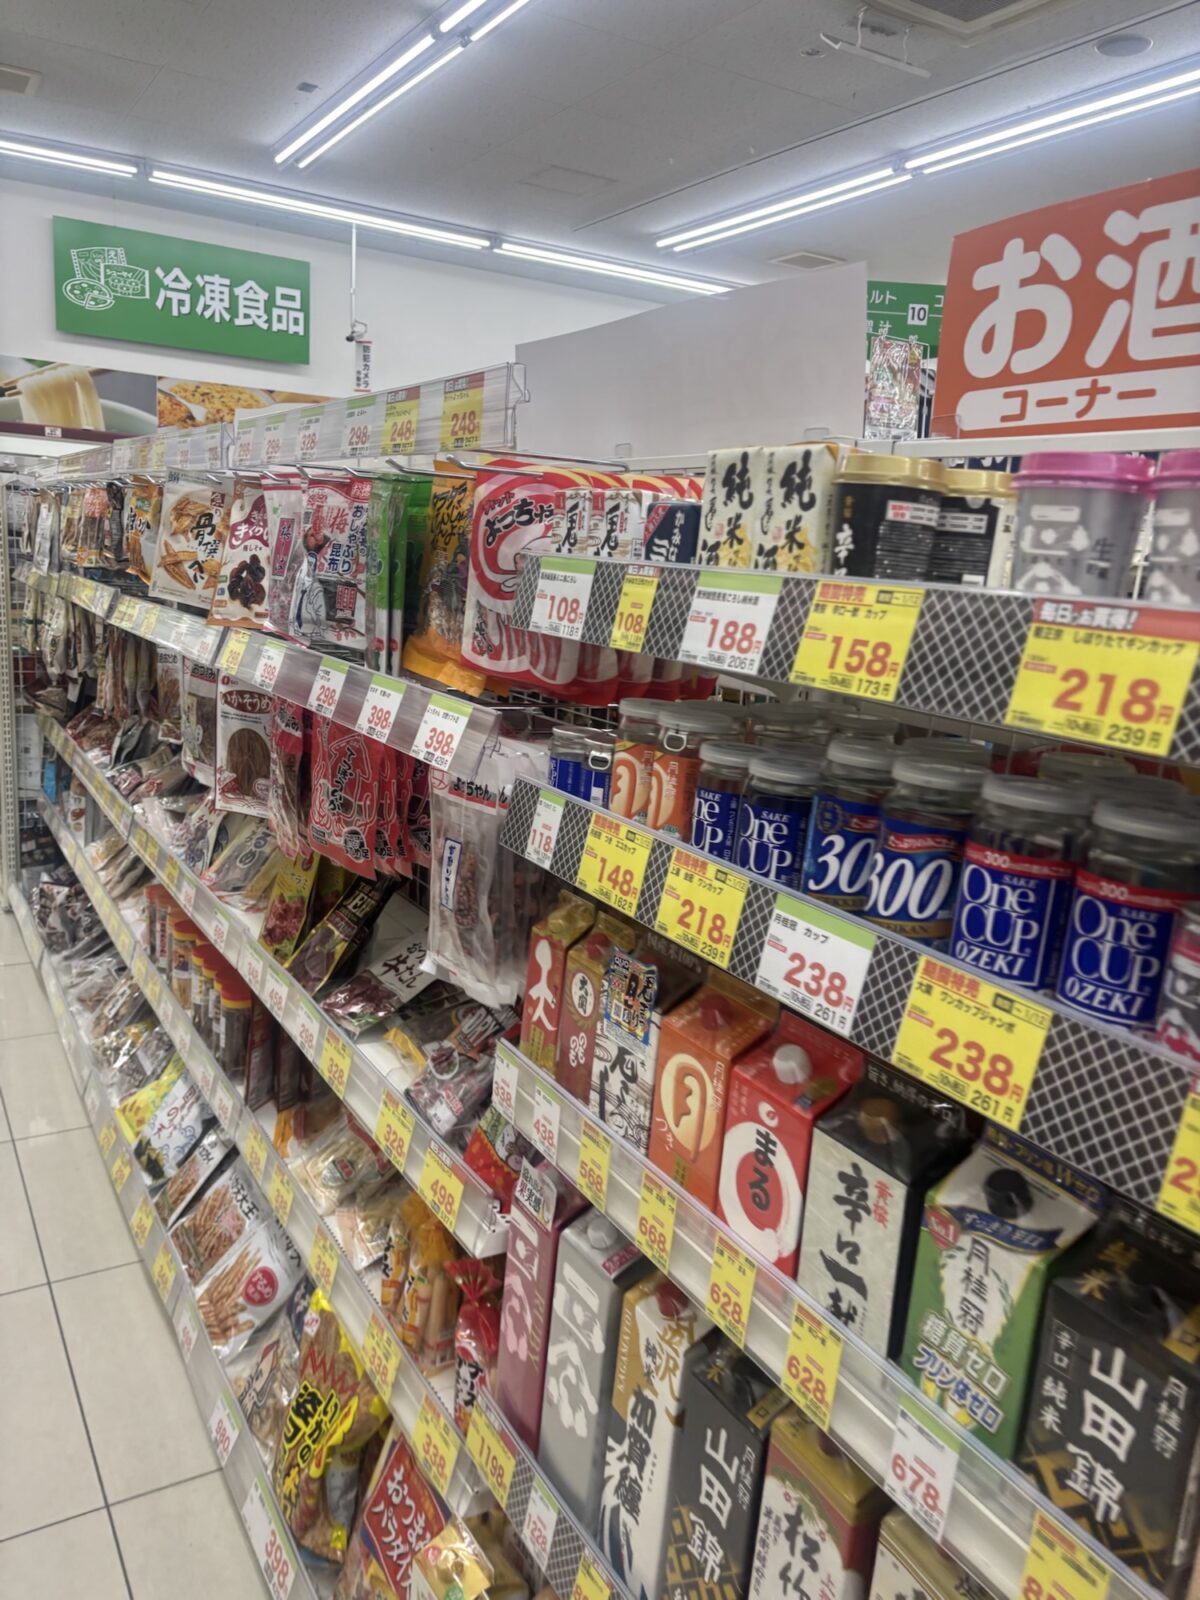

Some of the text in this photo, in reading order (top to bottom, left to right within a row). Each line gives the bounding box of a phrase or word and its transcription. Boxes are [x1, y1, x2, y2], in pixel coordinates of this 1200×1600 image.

[154, 266, 305, 335] 冷凍食品
[962, 196, 1200, 378] お酒
[910, 306, 927, 321] 10
[1000, 378, 1157, 423] コーナー
[327, 542, 341, 573] 昆布
[706, 618, 762, 655] 188円
[827, 635, 900, 679] 158円
[855, 678, 893, 697] 173円
[1052, 668, 1175, 726] 218円
[366, 705, 389, 730] 398
[1105, 723, 1163, 749] 239円
[423, 727, 450, 757] 398
[700, 790, 722, 801] SAKE
[761, 811, 791, 823] SAKE
[598, 857, 639, 900] 148円
[808, 834, 877, 894] 30
[983, 851, 1011, 868] 300
[962, 864, 1036, 914] One
[1003, 873, 1038, 889] SAKE
[1099, 882, 1129, 900] 300
[613, 893, 634, 912] 162円
[1074, 895, 1157, 950] One
[677, 898, 732, 949] 218円
[803, 927, 830, 945] カップ
[960, 903, 1039, 956] CUP
[700, 941, 726, 963] 239円
[955, 940, 1026, 977] OZEKI
[1071, 936, 1161, 995] CUP
[783, 952, 855, 1014] 238円
[922, 958, 981, 1000] 期間特売
[1064, 976, 1145, 1017] OZEKI
[814, 1002, 848, 1030] 261円
[940, 990, 1017, 1035] ワンカップジャンボ
[929, 1027, 1026, 1105] 238円
[970, 1089, 1015, 1124] 261円
[383, 1123, 405, 1158] 328
[579, 1162, 604, 1193] 568
[1167, 1156, 1200, 1197] 2
[429, 1179, 455, 1216] 498
[638, 1215, 667, 1253] 668
[958, 1237, 991, 1336] 月桂冠
[922, 1312, 1009, 1396] 糖質ゼロ
[912, 1344, 1004, 1433] プリン体ゼロ
[1065, 1347, 1148, 1524] 山田錦
[687, 1426, 739, 1584] 山田錦
